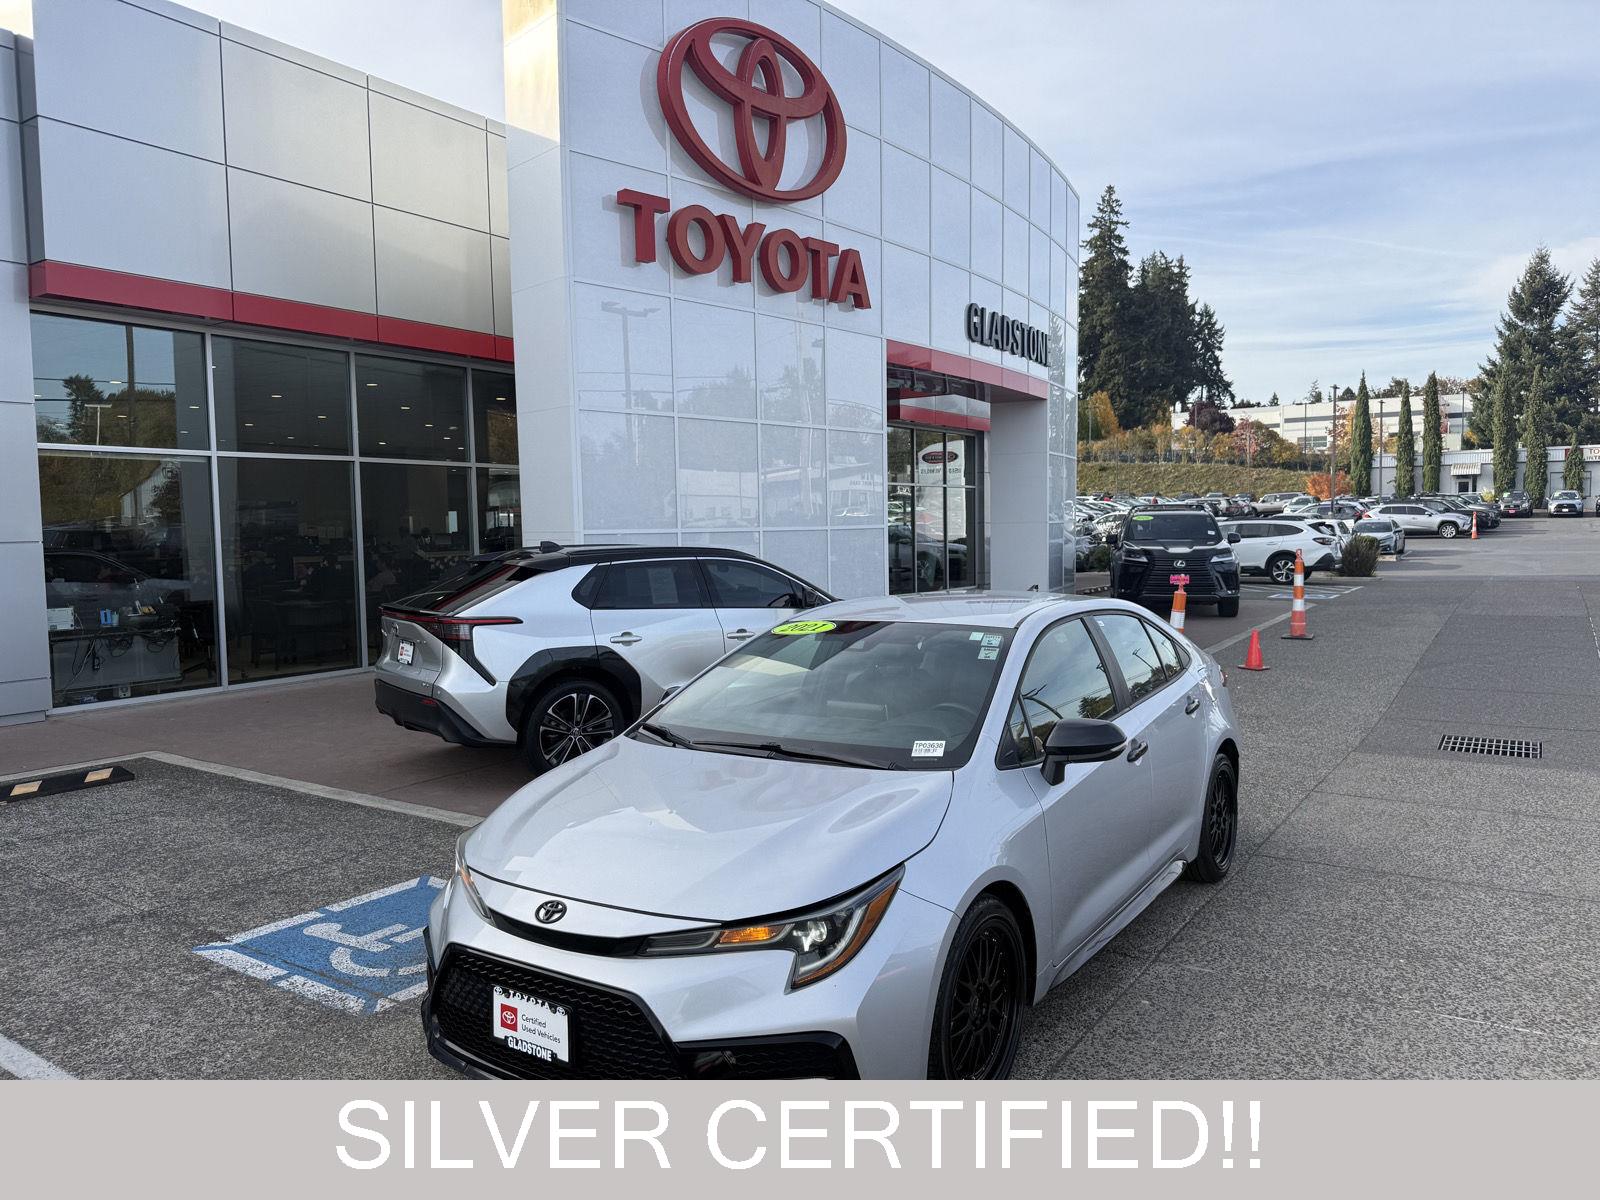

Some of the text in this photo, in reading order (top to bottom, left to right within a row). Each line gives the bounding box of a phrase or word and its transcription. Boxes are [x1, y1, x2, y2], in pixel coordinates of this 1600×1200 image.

[617, 188, 871, 310] TOYOTA
[966, 303, 1051, 368] GLADSTONE
[509, 990, 550, 1010] TOYOTA
[521, 1014, 546, 1028] Certified
[521, 1024, 561, 1043] Used Vehicles
[508, 1036, 552, 1061] GLADSTONE
